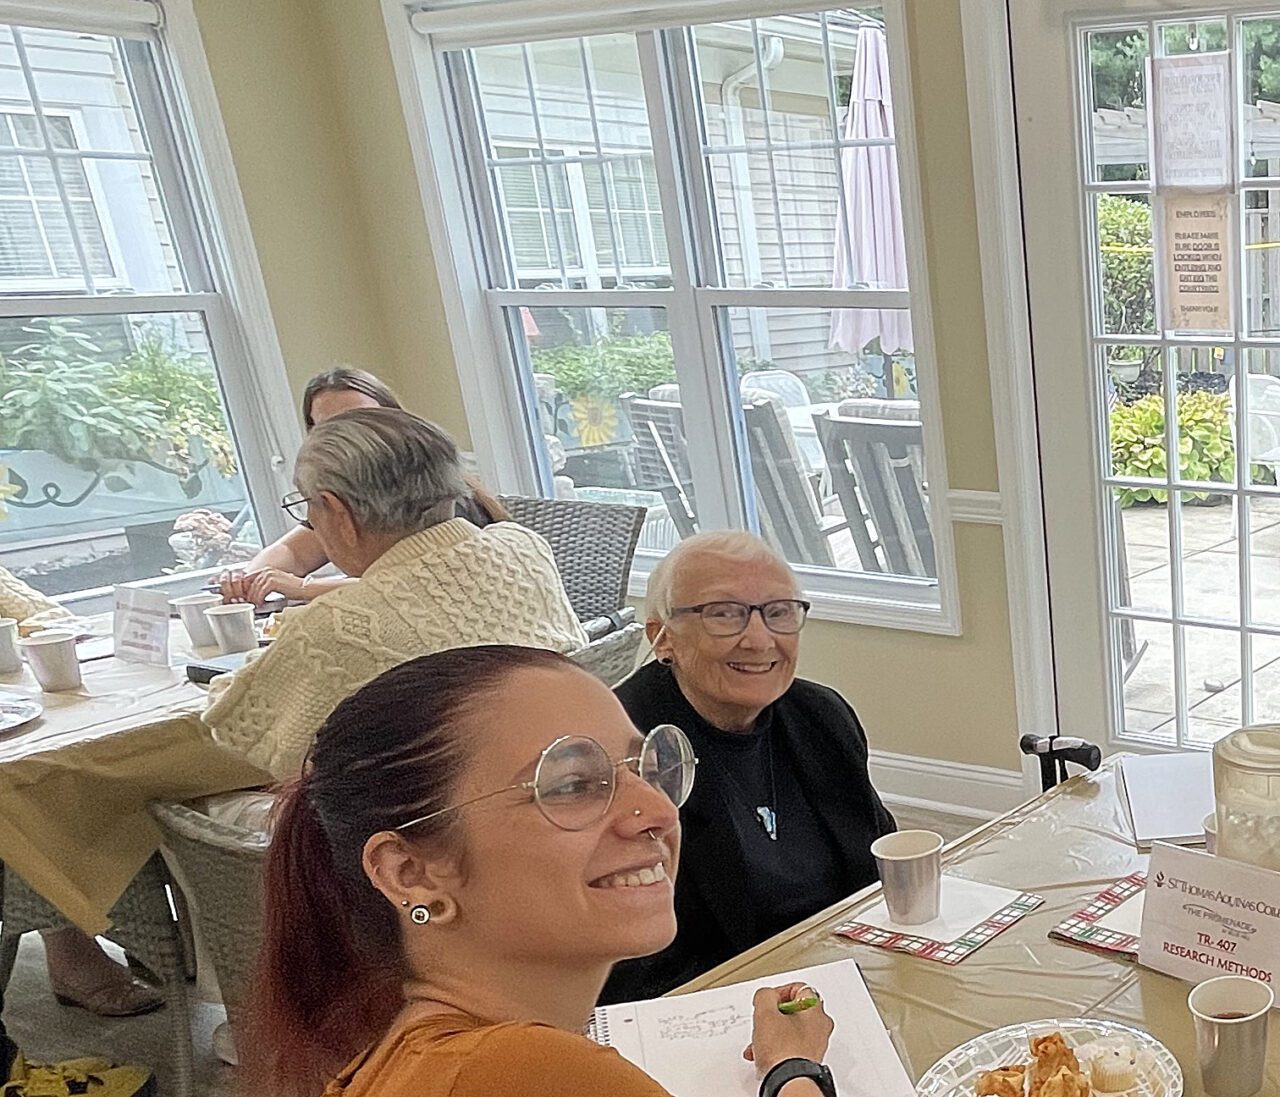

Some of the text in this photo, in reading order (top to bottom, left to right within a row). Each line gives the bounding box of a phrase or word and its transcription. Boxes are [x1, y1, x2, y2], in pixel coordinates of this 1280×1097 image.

[1179, 879, 1216, 901] THOMAS
[1215, 890, 1256, 912] AQUINAS
[1187, 907, 1252, 931] THE PROMENADE
[1216, 938, 1237, 952] 407
[1162, 942, 1273, 983] RESEARCH METHODS
